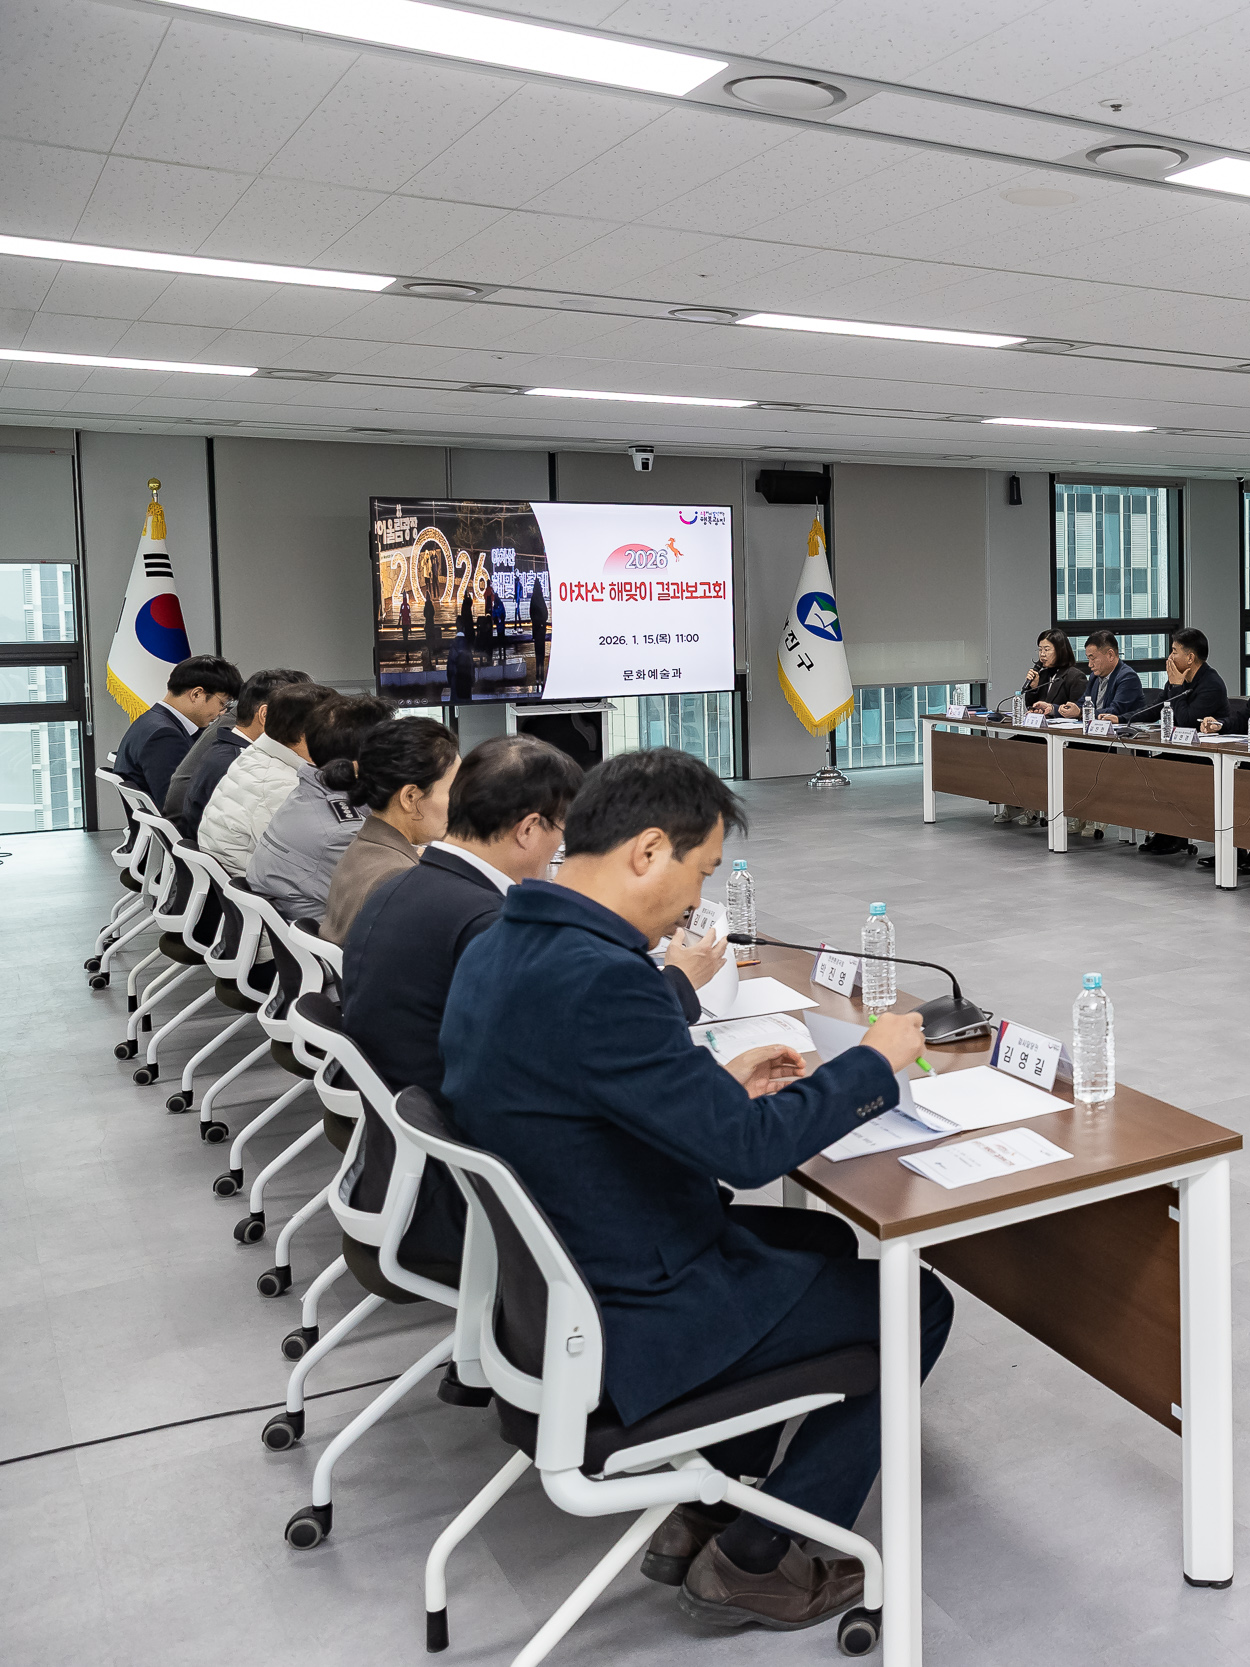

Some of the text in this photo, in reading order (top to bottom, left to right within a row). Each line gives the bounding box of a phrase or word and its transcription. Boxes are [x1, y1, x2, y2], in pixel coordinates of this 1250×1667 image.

[625, 549, 669, 570] 2026
[559, 580, 726, 602] 아차산 해맞이 결과보고회
[598, 635, 628, 646] 2026.
[675, 633, 700, 643] 11:00
[622, 667, 682, 681] 문화예술과
